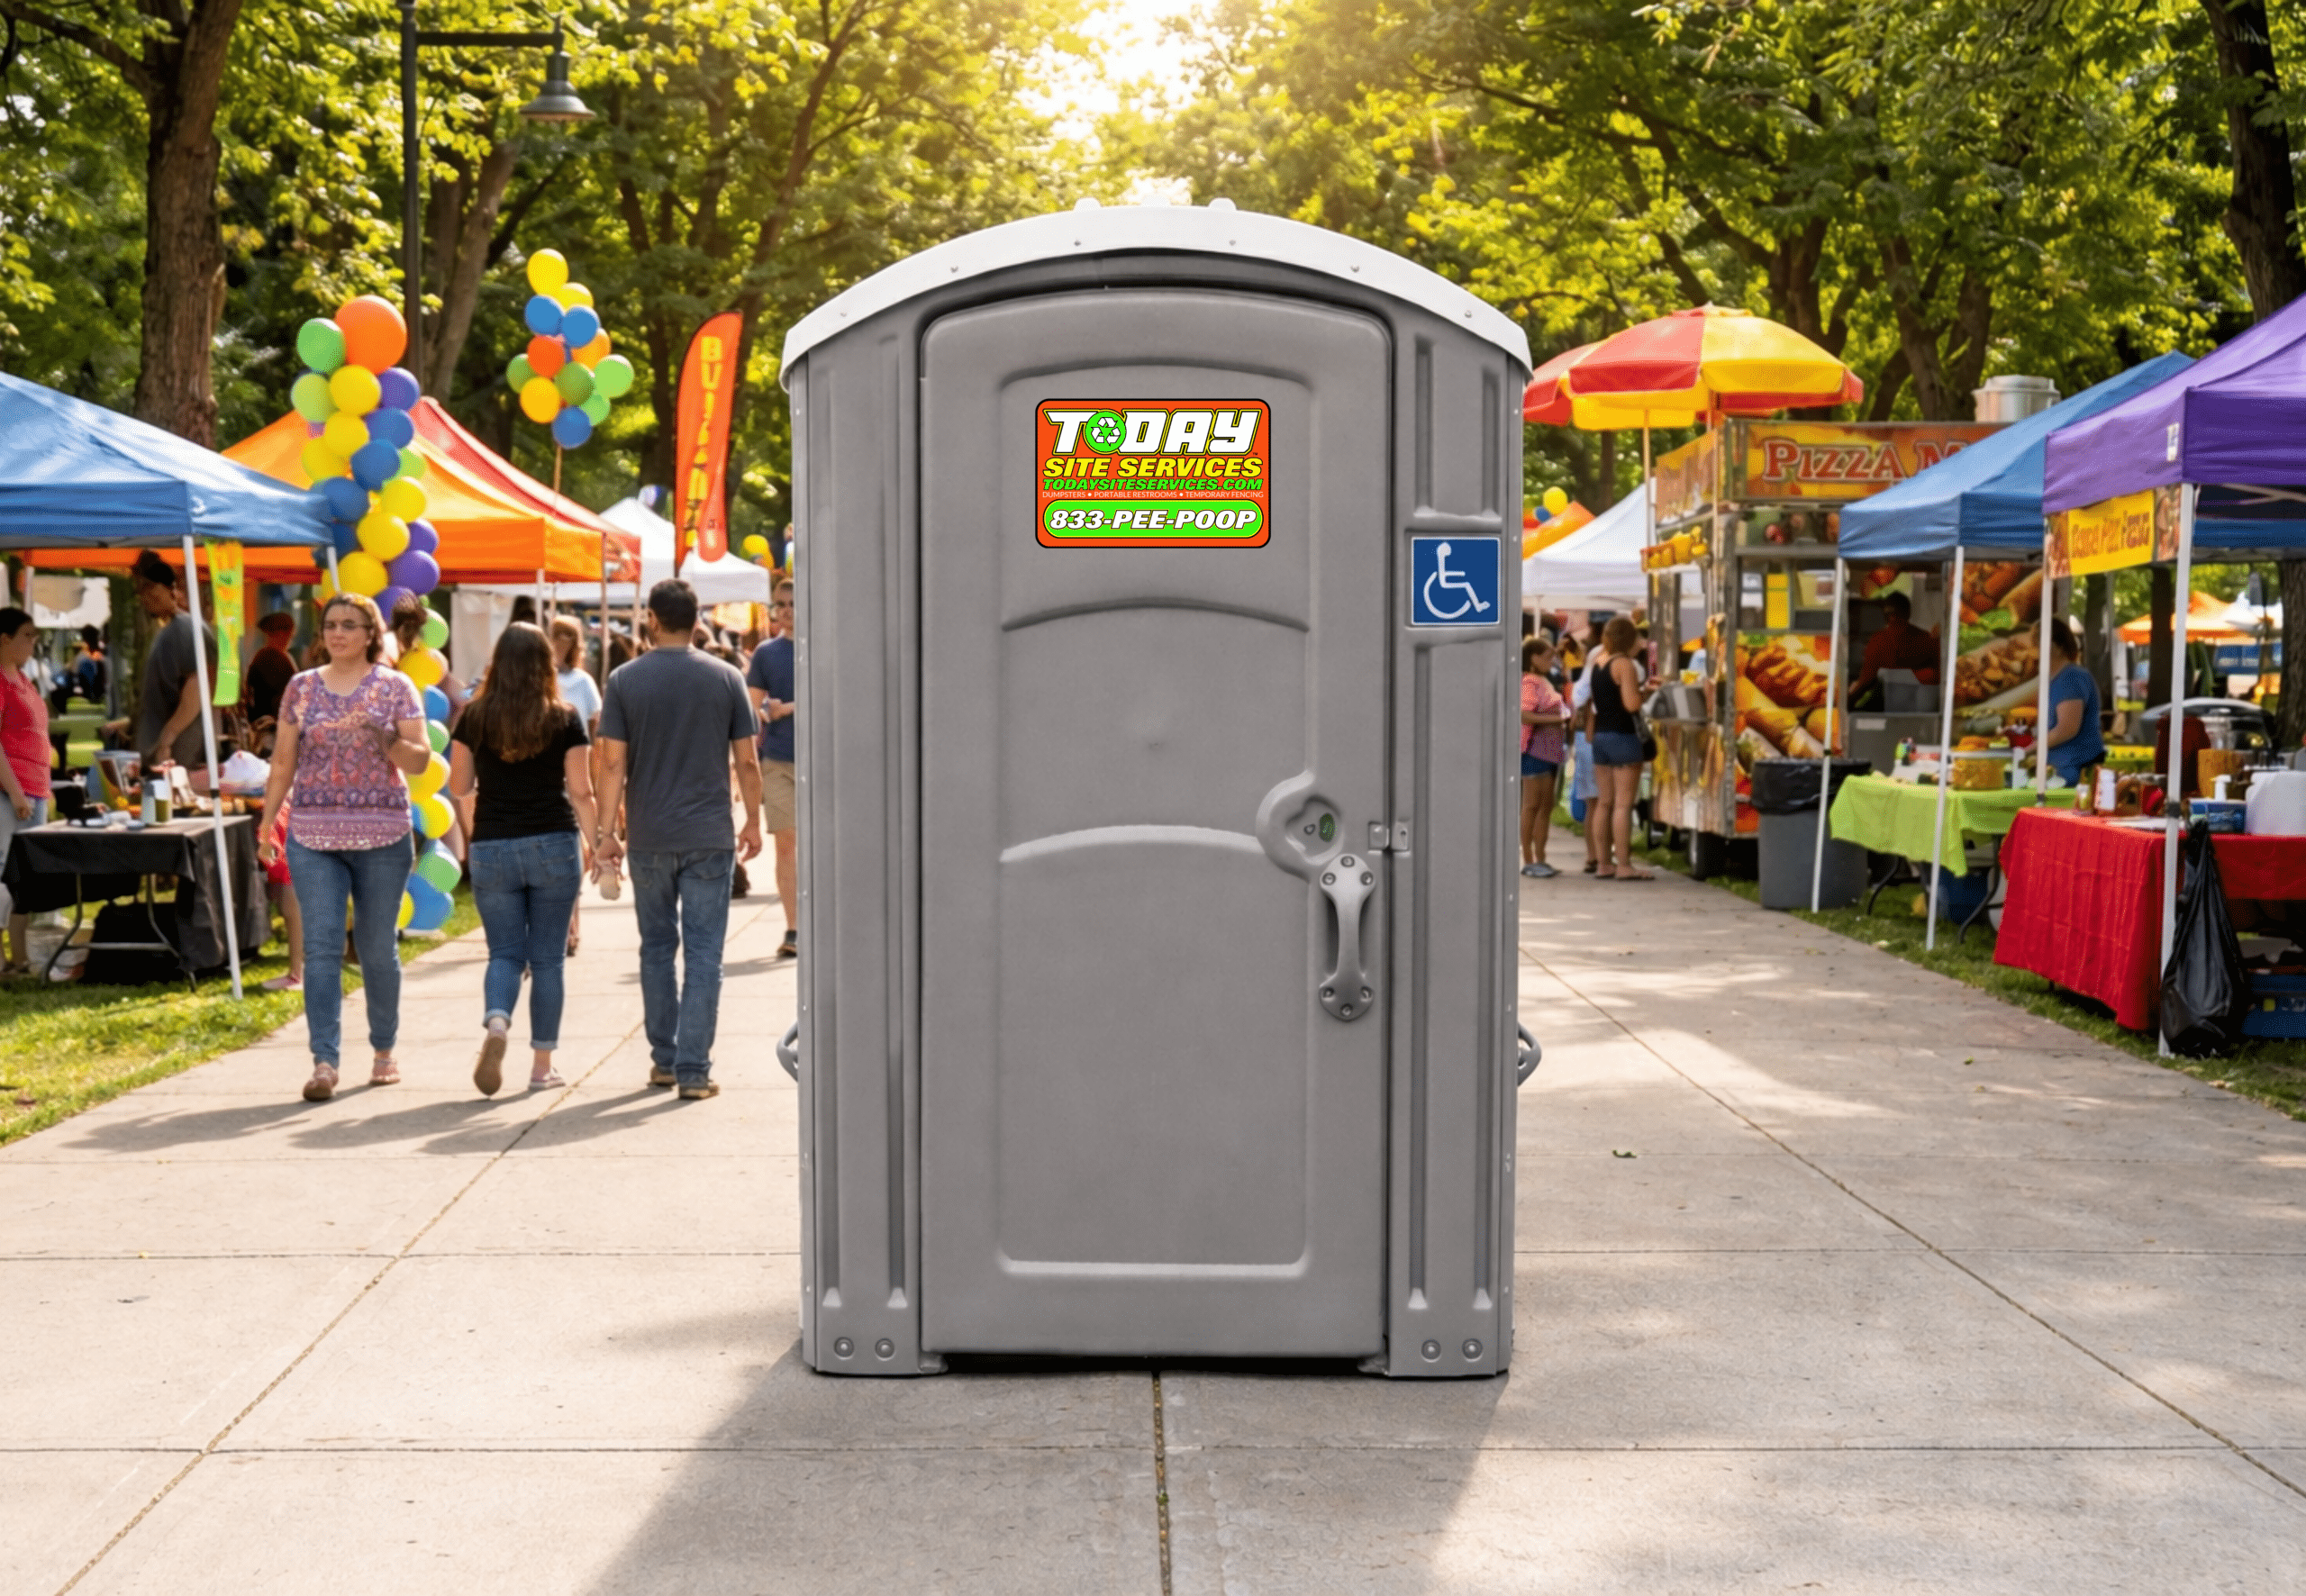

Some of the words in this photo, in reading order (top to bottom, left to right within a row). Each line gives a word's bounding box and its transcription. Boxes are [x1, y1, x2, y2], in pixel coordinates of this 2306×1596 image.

[1042, 457, 1112, 477] SITE
[1117, 457, 1263, 477] SERVICES
[1763, 440, 1907, 481] PIZZA
[1042, 478, 1264, 491] TODAYSITESERVICES.COM
[1049, 509, 1258, 530] 833-PEE-POOP
